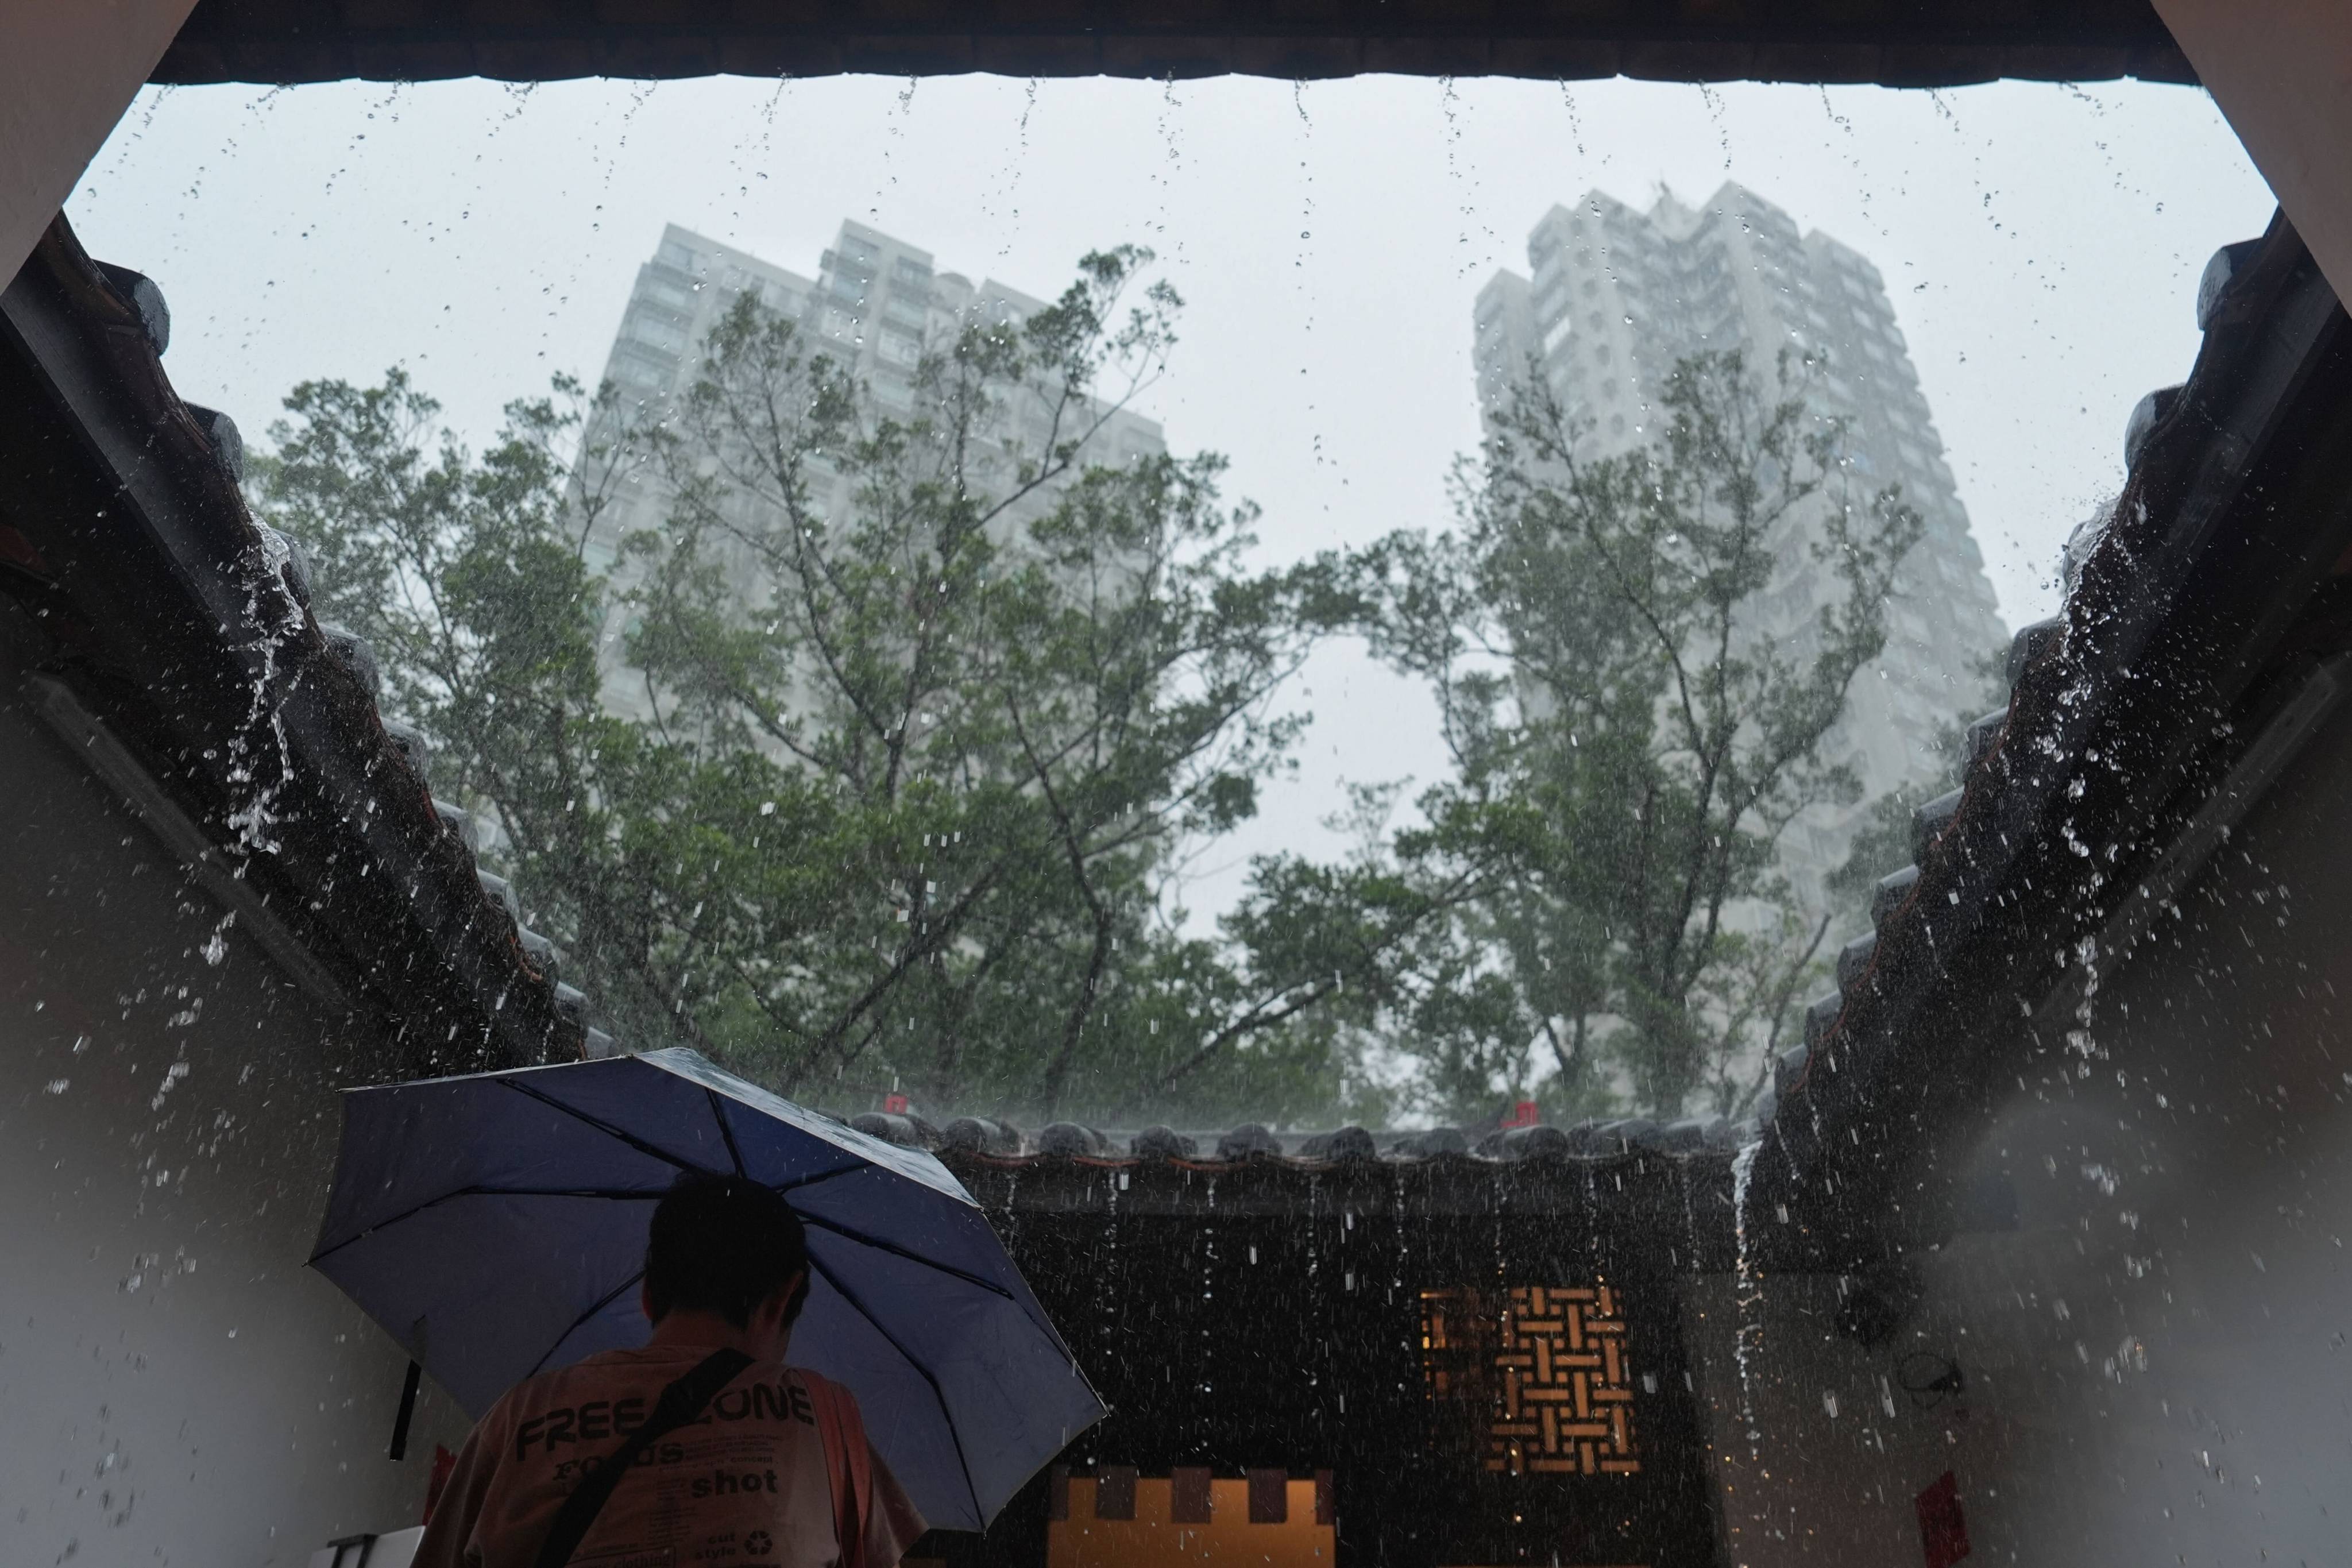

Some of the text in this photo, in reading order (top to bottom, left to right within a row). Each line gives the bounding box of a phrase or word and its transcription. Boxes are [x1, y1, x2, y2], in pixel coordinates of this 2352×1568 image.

[516, 1397, 644, 1462] FREE
[689, 1382, 814, 1426] ONE
[553, 1443, 685, 1481] FOUS
[691, 1469, 778, 1499] shot
[695, 1546, 736, 1560] style
[708, 1532, 736, 1544] cut
